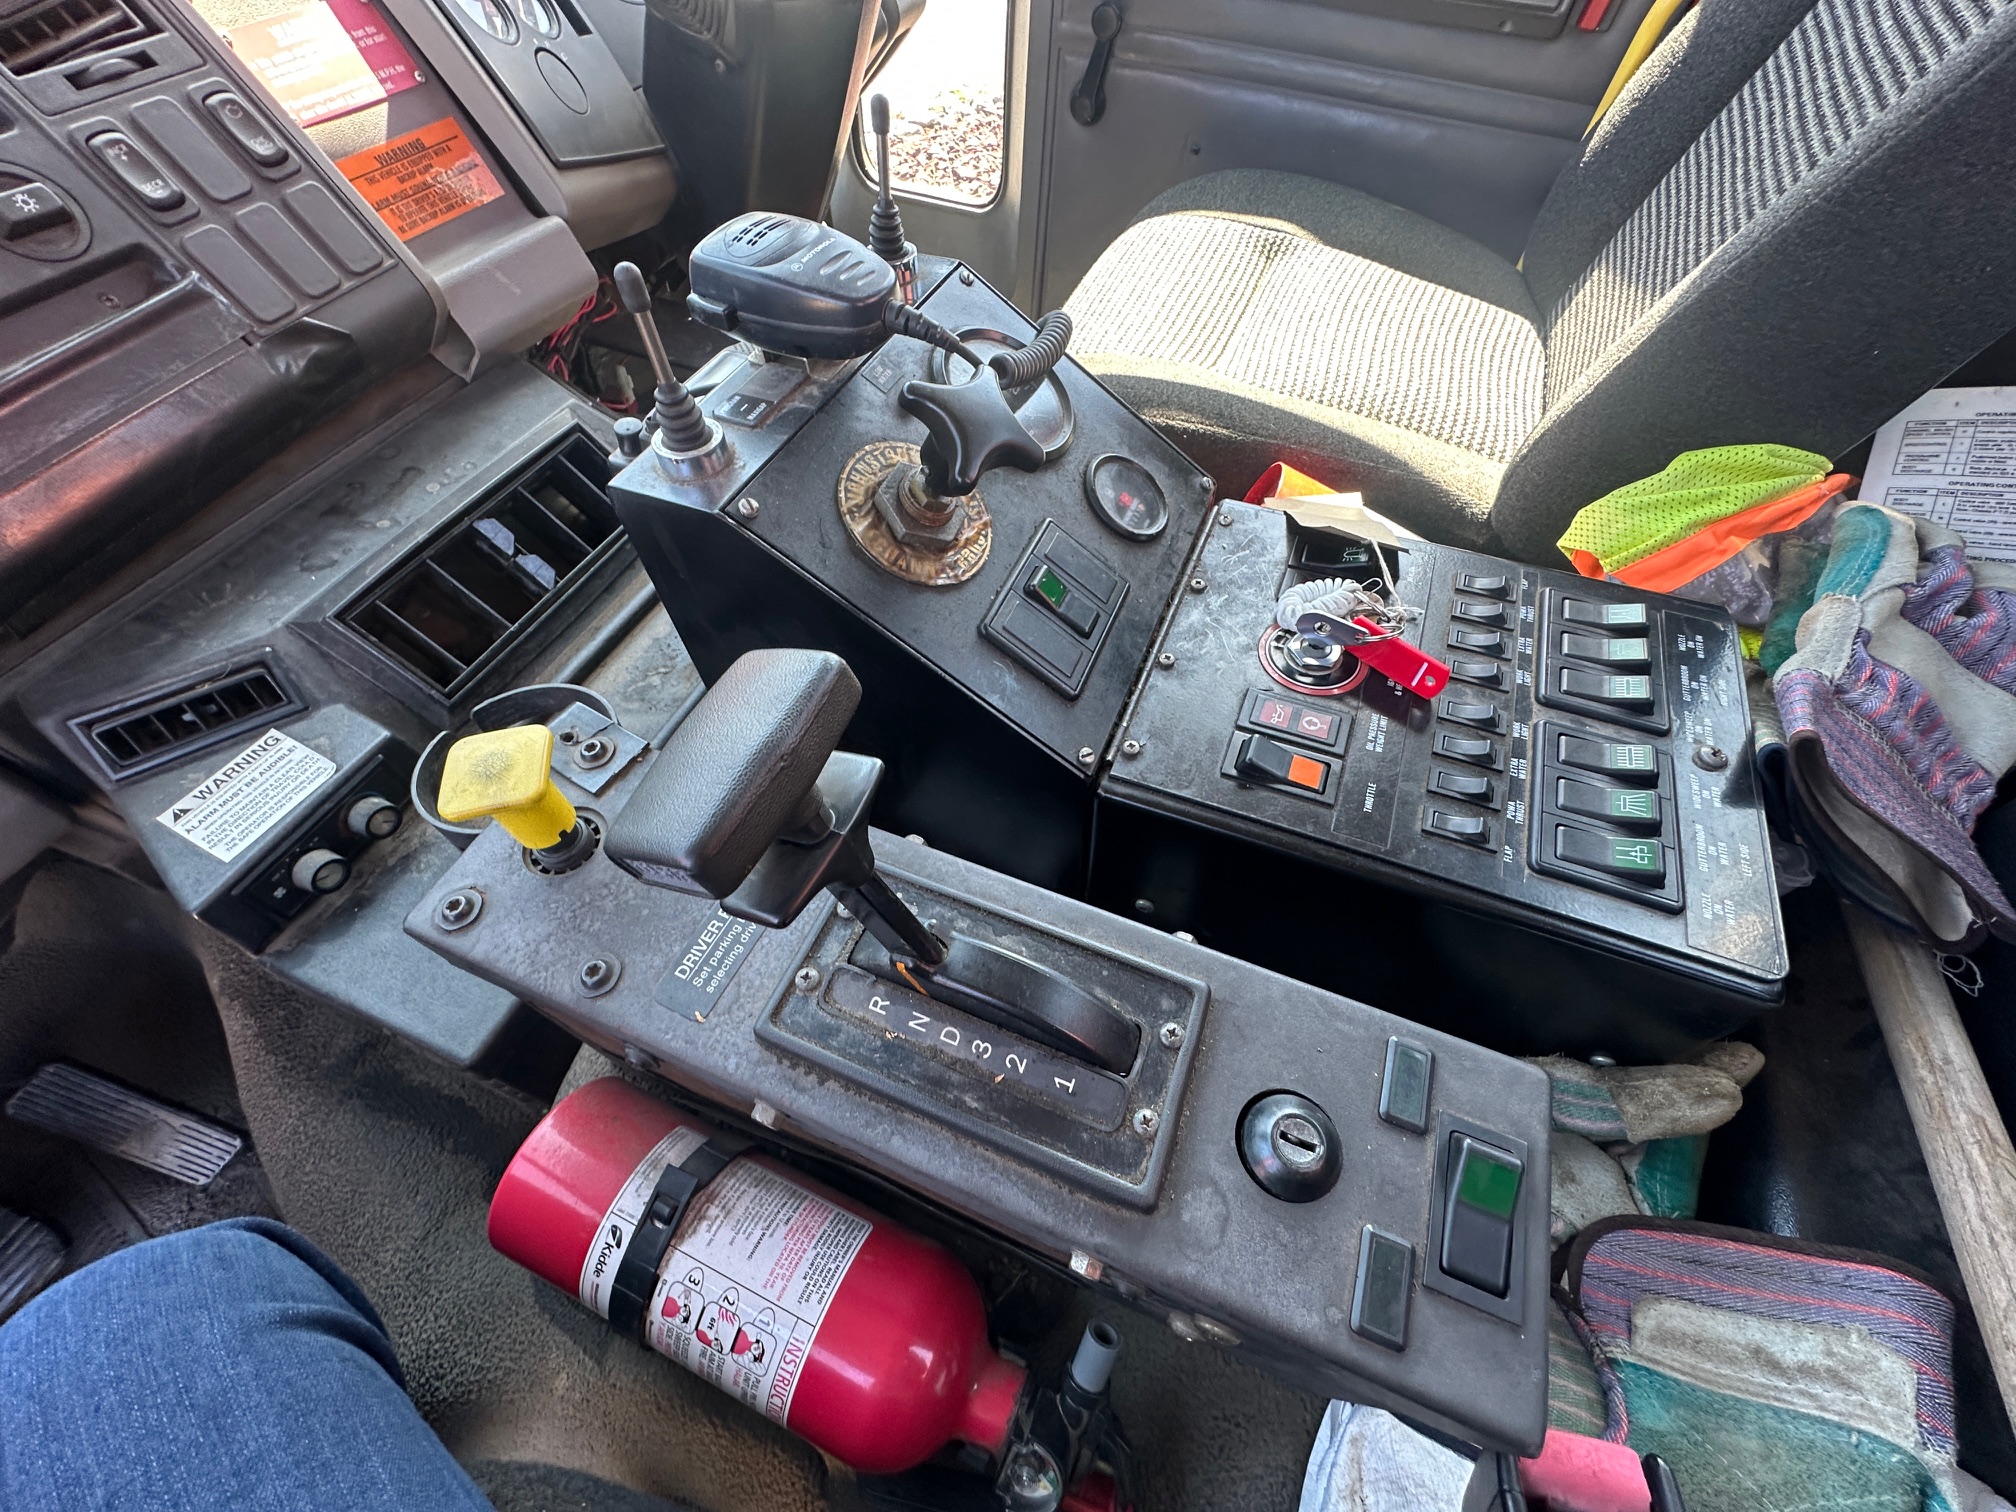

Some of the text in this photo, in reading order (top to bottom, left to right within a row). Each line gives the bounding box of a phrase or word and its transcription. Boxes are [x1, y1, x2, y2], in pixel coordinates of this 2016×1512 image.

[372, 137, 426, 166] WARNING
[364, 174, 380, 185] THIS
[377, 165, 402, 180] VEHICLE
[405, 151, 434, 168] EQUIPPED
[396, 169, 419, 183] BACKUP
[801, 238, 836, 263] MOTOROLA
[1678, 634, 1686, 652] NOZZLE
[1696, 642, 1704, 658] WATER
[1680, 664, 1691, 702] GUTTERBROOM
[1700, 683, 1709, 700] WATER
[1367, 713, 1378, 740] PRESSURE
[1374, 715, 1388, 753] WEIGHT LIMIT
[1512, 721, 1521, 738] WORK
[1520, 724, 1530, 740] LIGHT
[1704, 727, 1714, 746] WATER
[191, 733, 281, 803] WARNING
[1510, 758, 1518, 777] EXTRA
[1518, 758, 1528, 780] WATER
[184, 807, 219, 834] ALARM
[217, 786, 247, 808] MUST
[243, 776, 259, 787] BE
[256, 745, 298, 777] AUDIBLE!
[235, 810, 268, 837] OPERATOR
[273, 774, 311, 806] RESPONSIBLE
[309, 765, 322, 775] FOR
[1363, 782, 1376, 813] THROTTLE
[1690, 774, 1702, 810] WIDESWEEP
[1702, 790, 1711, 800] ON
[1711, 786, 1722, 808] WATER
[201, 818, 230, 841] FAILURE
[238, 786, 270, 811] MAINTAIN
[273, 765, 295, 783] CLEAR
[207, 828, 235, 850] RESULT
[241, 800, 270, 823] SERIOUS
[268, 782, 291, 801] INJURY
[299, 758, 321, 774] DEATH
[214, 827, 228, 838] THE
[227, 799, 262, 827] DIRECTION
[270, 773, 294, 792] TRAVEL
[237, 828, 254, 842] SAFE
[252, 802, 286, 830] OPERATION
[292, 784, 307, 795] THIS
[305, 766, 329, 785] VEHICLE
[1506, 801, 1516, 820] POWA
[1514, 800, 1525, 824] THRUST
[1504, 845, 1513, 863] FLAP
[1695, 824, 1708, 872] GUTTERBROOM
[1708, 846, 1718, 856] ON
[1718, 842, 1730, 866] WATER
[1738, 843, 1752, 878] LEFT SIDE
[1701, 892, 1712, 920] NOZZLE
[1714, 904, 1724, 915] ON
[1724, 900, 1736, 926] WATER
[674, 920, 723, 980] DRIVER
[692, 966, 711, 987] Set
[710, 924, 742, 967] parking
[706, 944, 744, 994] selecting
[868, 996, 1076, 1094] R N D 3 2 1
[746, 1230, 766, 1261] WARNING:
[793, 1239, 805, 1256] AFTER
[804, 1233, 816, 1247] MUST
[593, 1243, 612, 1278] Kidde
[761, 1241, 791, 1289] LOCATED ON THE
[784, 1256, 795, 1271] DATE
[784, 1254, 804, 1283] REMOVED
[806, 1250, 821, 1270] INJURY
[807, 1260, 822, 1281] COULD
[816, 1249, 835, 1278] CAUTIONS
[687, 1273, 700, 1287] 3
[768, 1272, 780, 1289] YEAR
[801, 1270, 810, 1280] OR
[811, 1277, 819, 1288] ON
[816, 1240, 854, 1305] OWNER'S MANUAL AND
[820, 1266, 832, 1283] READ
[722, 1293, 735, 1307] 2
[775, 1282, 787, 1302] FROM
[796, 1281, 811, 1305] RESULT
[803, 1288, 814, 1303] THIS
[813, 1283, 824, 1296] ALL
[706, 1315, 716, 1331] 6ft
[758, 1315, 770, 1327] 1
